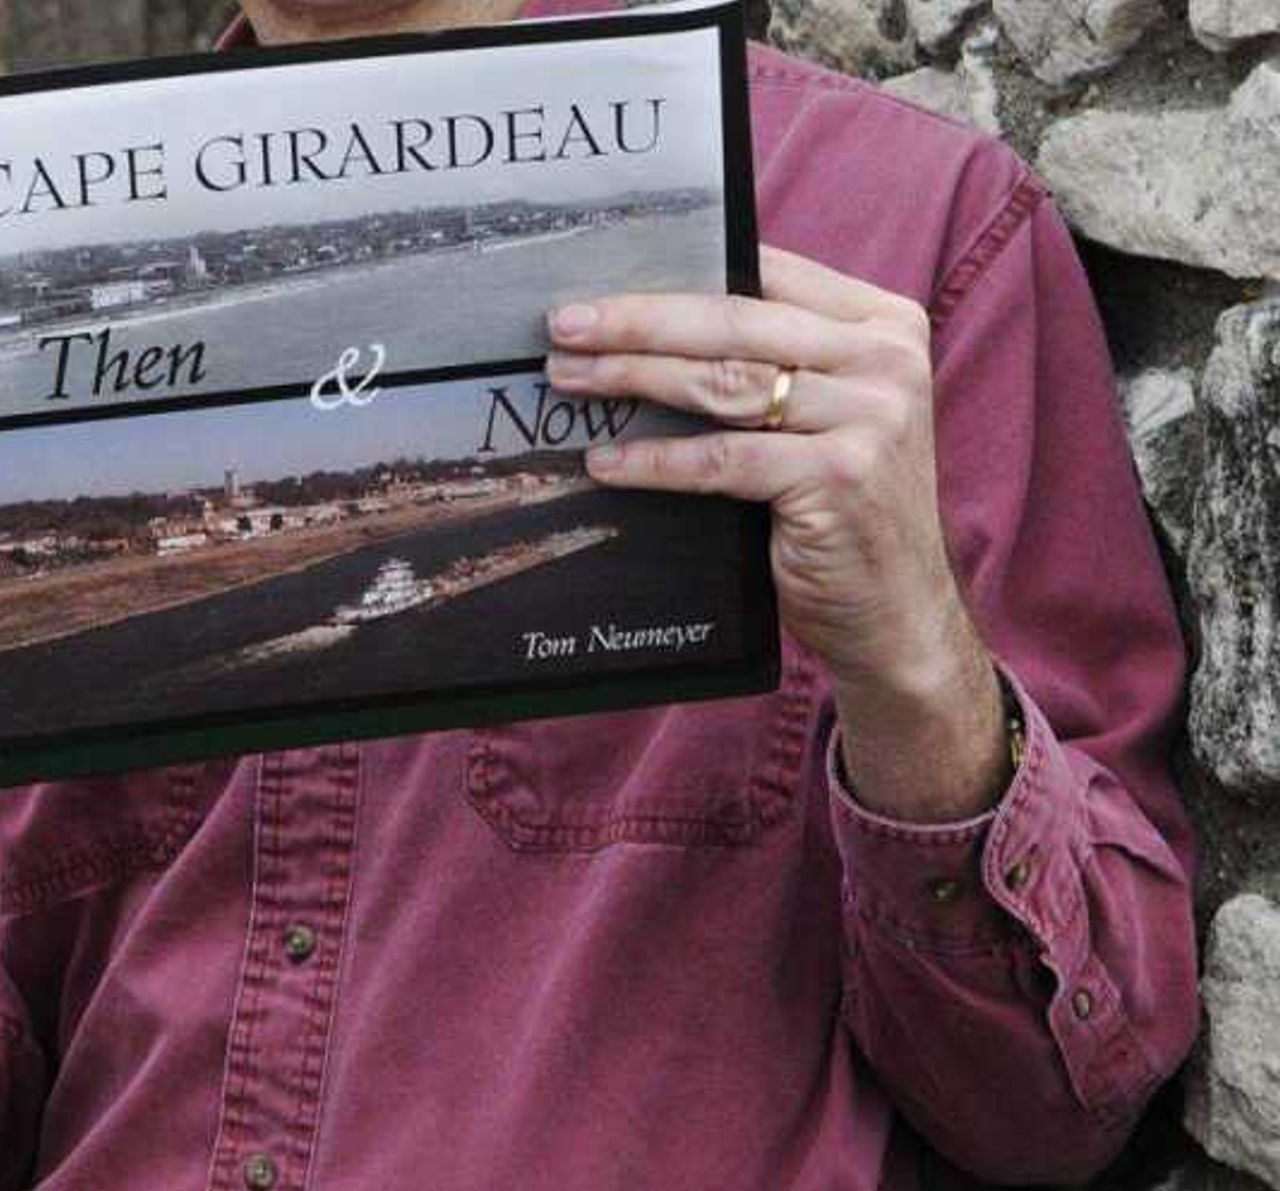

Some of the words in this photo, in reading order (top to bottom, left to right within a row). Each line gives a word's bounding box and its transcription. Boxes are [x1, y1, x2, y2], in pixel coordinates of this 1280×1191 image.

[194, 99, 667, 193] GIRARDEAU
[39, 327, 207, 400] Then
[310, 343, 387, 410] &
[477, 381, 640, 454] Now
[522, 630, 576, 659] Tom
[587, 622, 717, 653] Neumeyer
